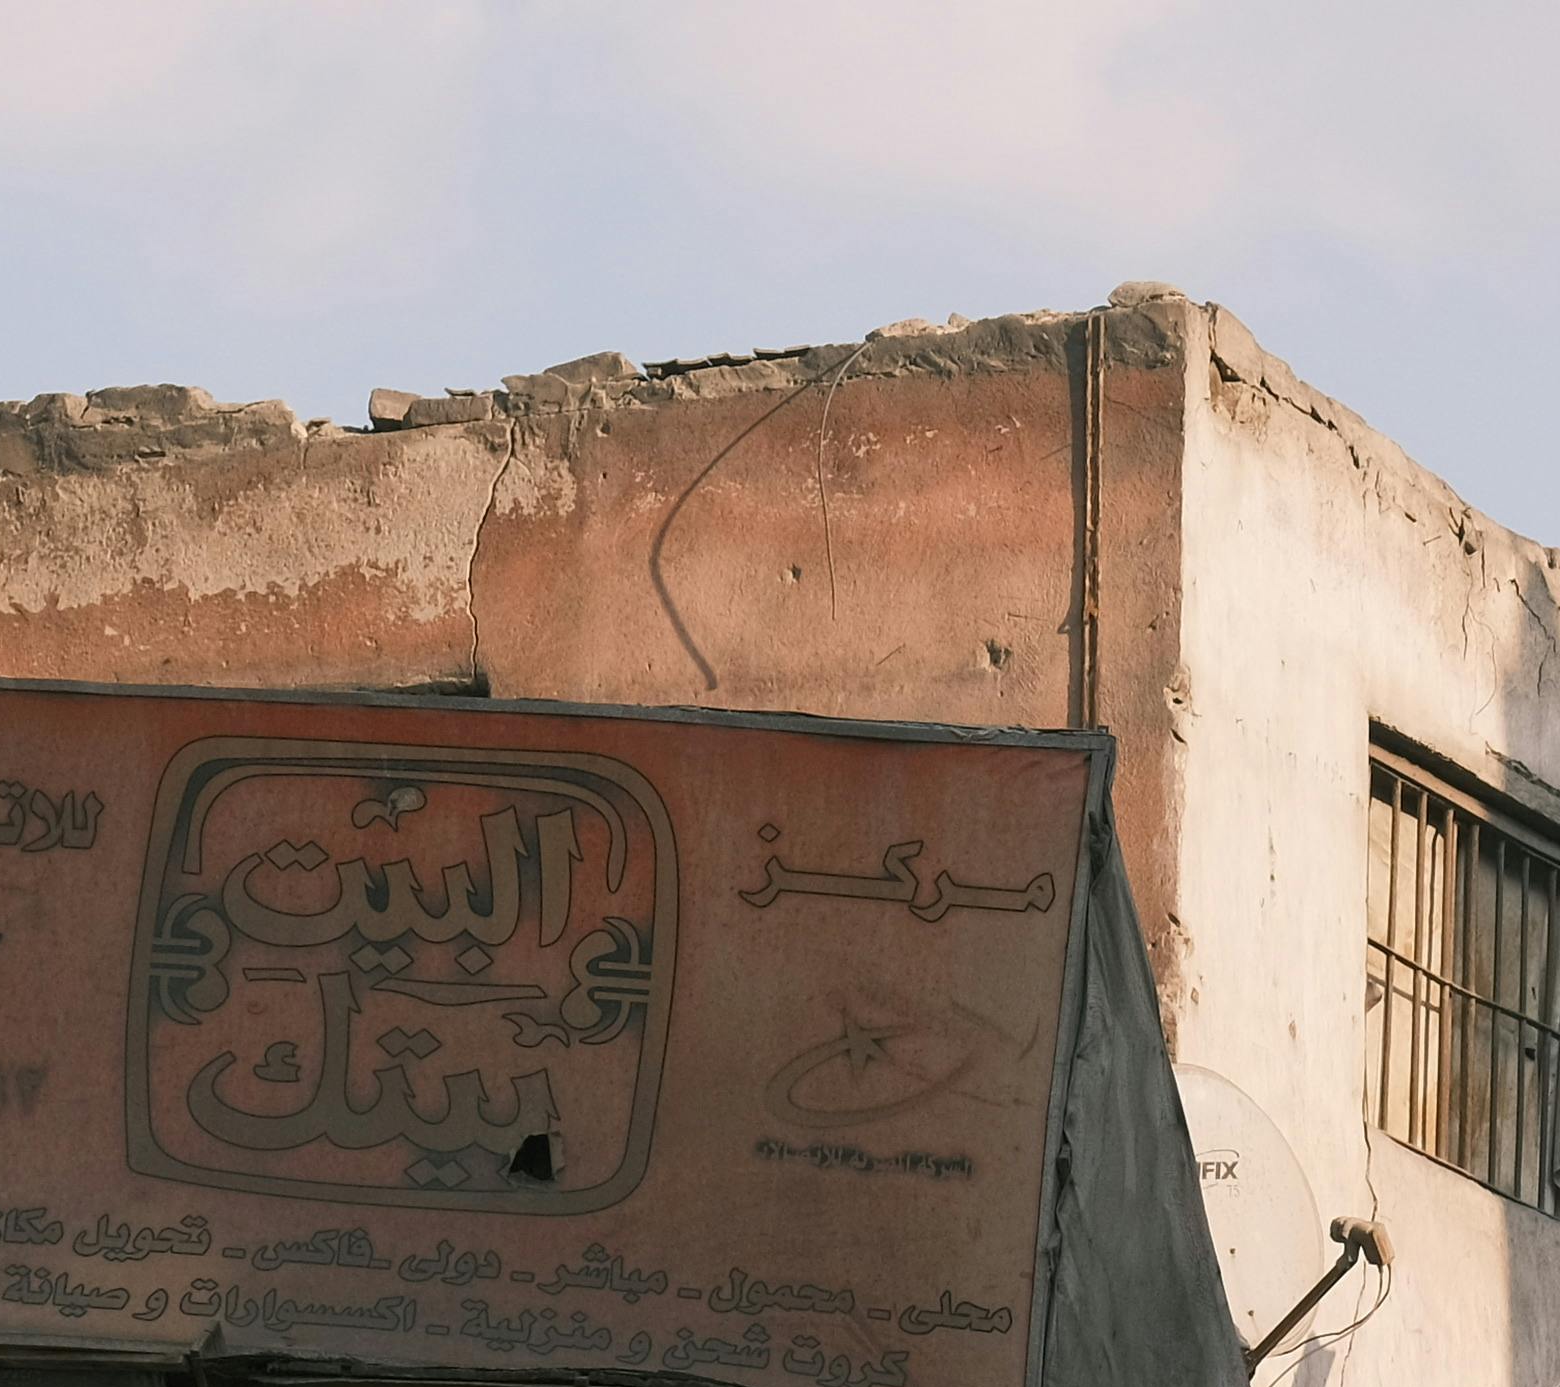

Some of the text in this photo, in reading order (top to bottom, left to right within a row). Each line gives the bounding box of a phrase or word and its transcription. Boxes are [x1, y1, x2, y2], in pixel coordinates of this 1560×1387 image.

[222, 805, 585, 976] البيت
[740, 821, 1056, 923] مركز
[72, 1213, 212, 1263] تحويل
[252, 1228, 376, 1270] فاكس
[398, 1240, 502, 1284] دولى
[0, 1263, 130, 1320] صيانة
[537, 1243, 668, 1302] مباشر
[708, 1268, 856, 1315] محمول
[132, 1287, 169, 1321] و
[180, 1277, 417, 1333] اكسسوارات
[460, 1299, 613, 1355] منزلية
[899, 1291, 1013, 1335] محلى
[618, 1331, 652, 1365] و
[661, 1324, 772, 1371] شحن
